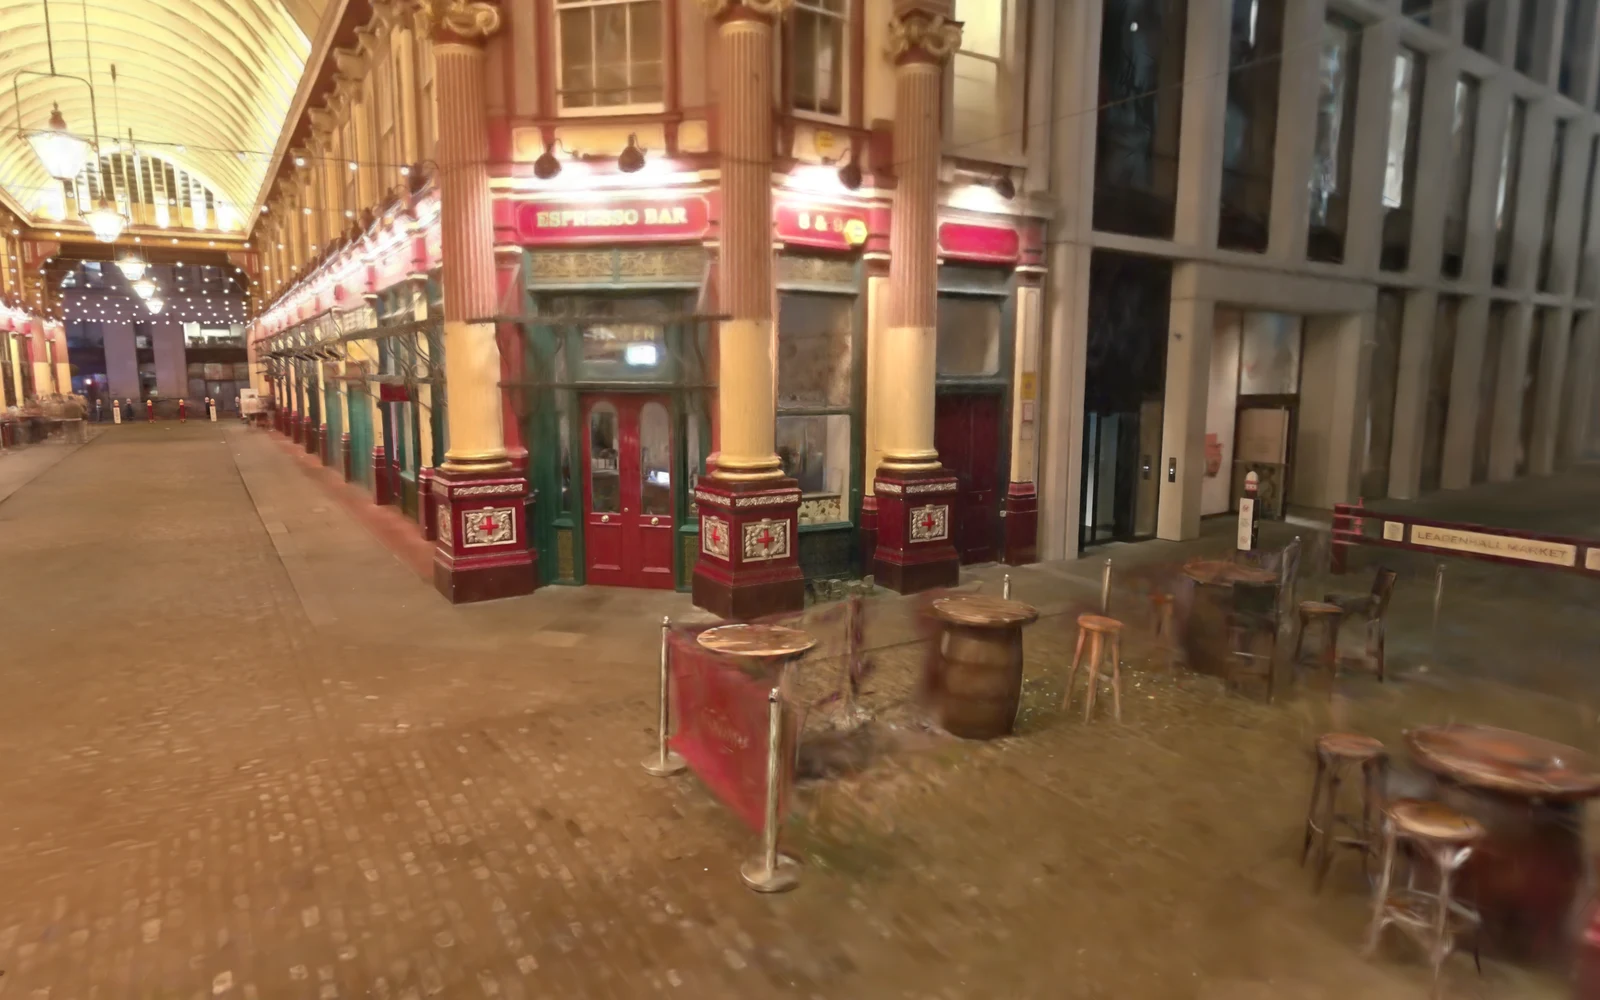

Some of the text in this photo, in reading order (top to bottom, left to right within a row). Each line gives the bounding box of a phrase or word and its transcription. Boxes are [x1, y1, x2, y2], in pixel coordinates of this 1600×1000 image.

[536, 206, 688, 228] ESPRESSO BAR
[814, 213, 828, 232] &
[1417, 531, 1568, 559] LEADENHALL MARKET
